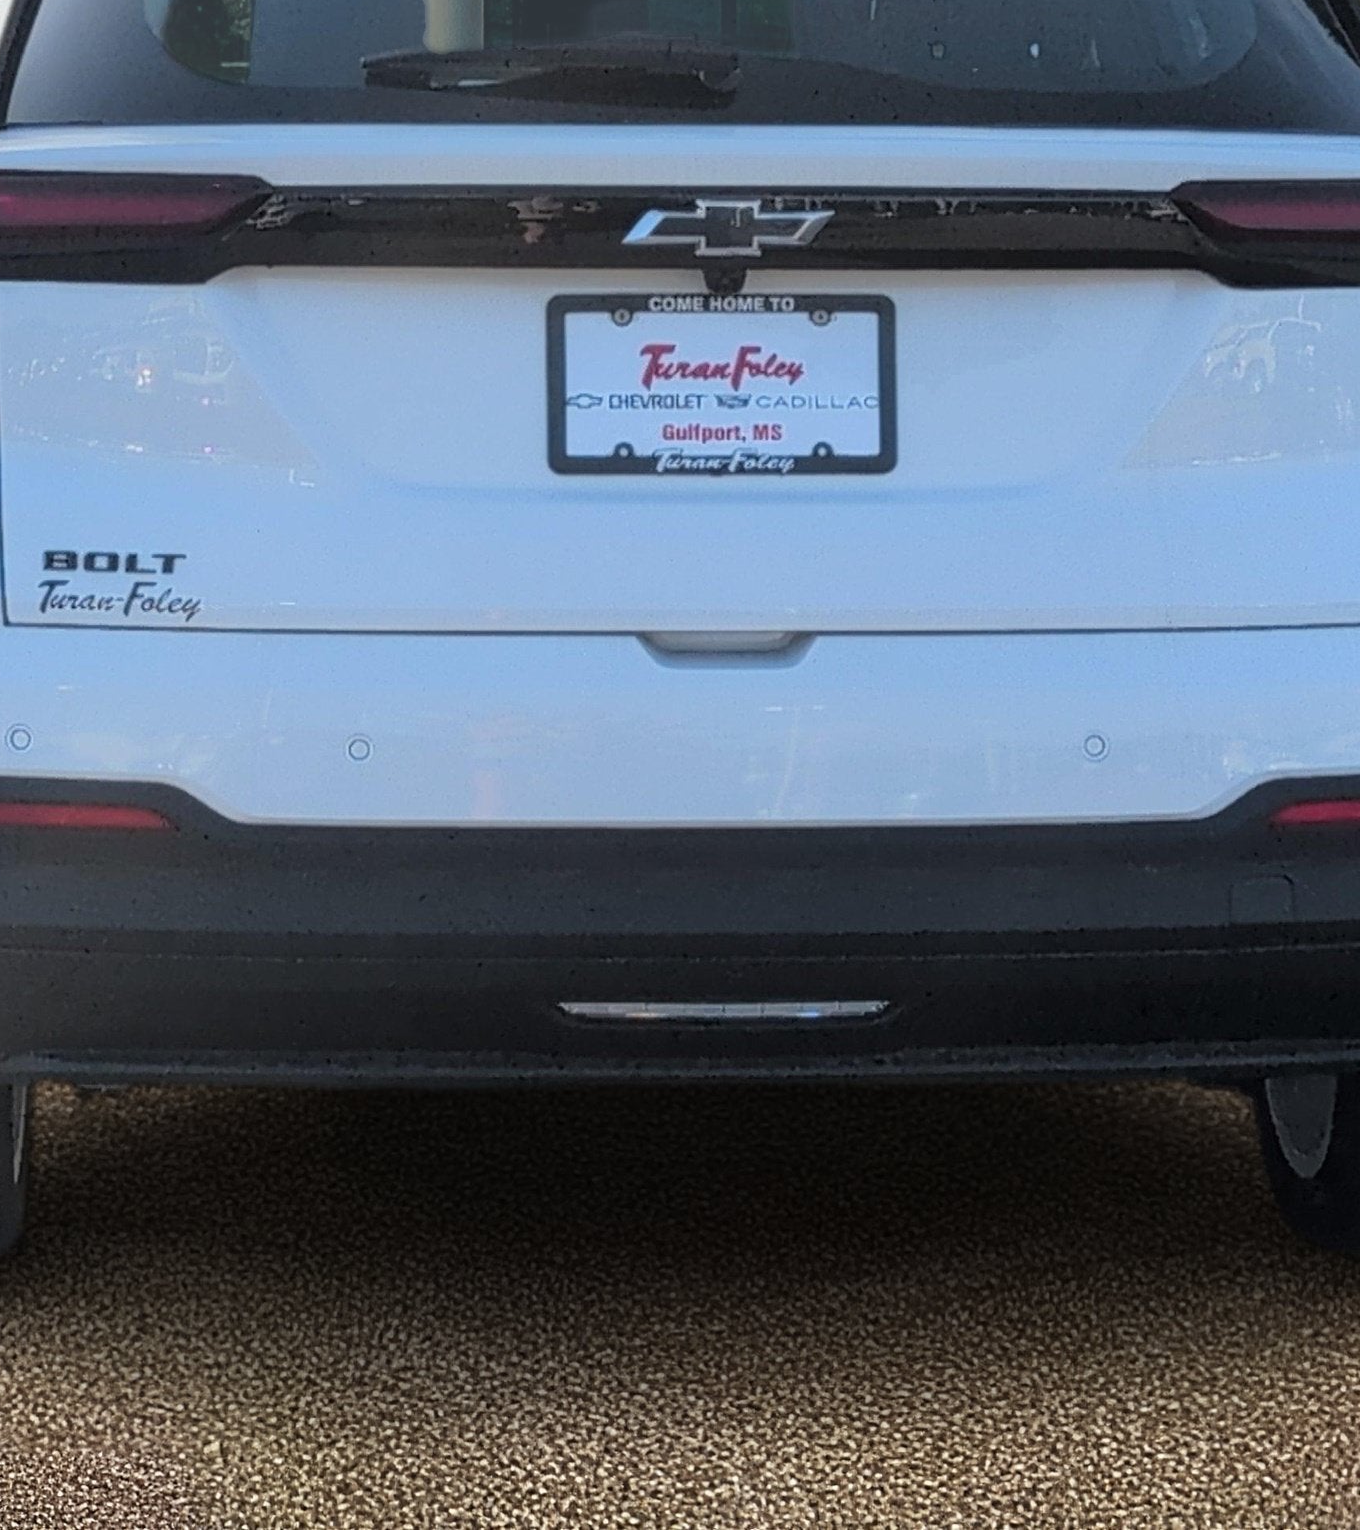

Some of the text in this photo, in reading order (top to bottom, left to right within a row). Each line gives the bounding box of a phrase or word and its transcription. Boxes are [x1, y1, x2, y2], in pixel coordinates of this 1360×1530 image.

[648, 297, 795, 312] COME HOME TO
[608, 393, 880, 410] CHEVROLET CADILLAC
[662, 423, 783, 444] Gulfport, MS
[42, 550, 187, 575] BOLT
